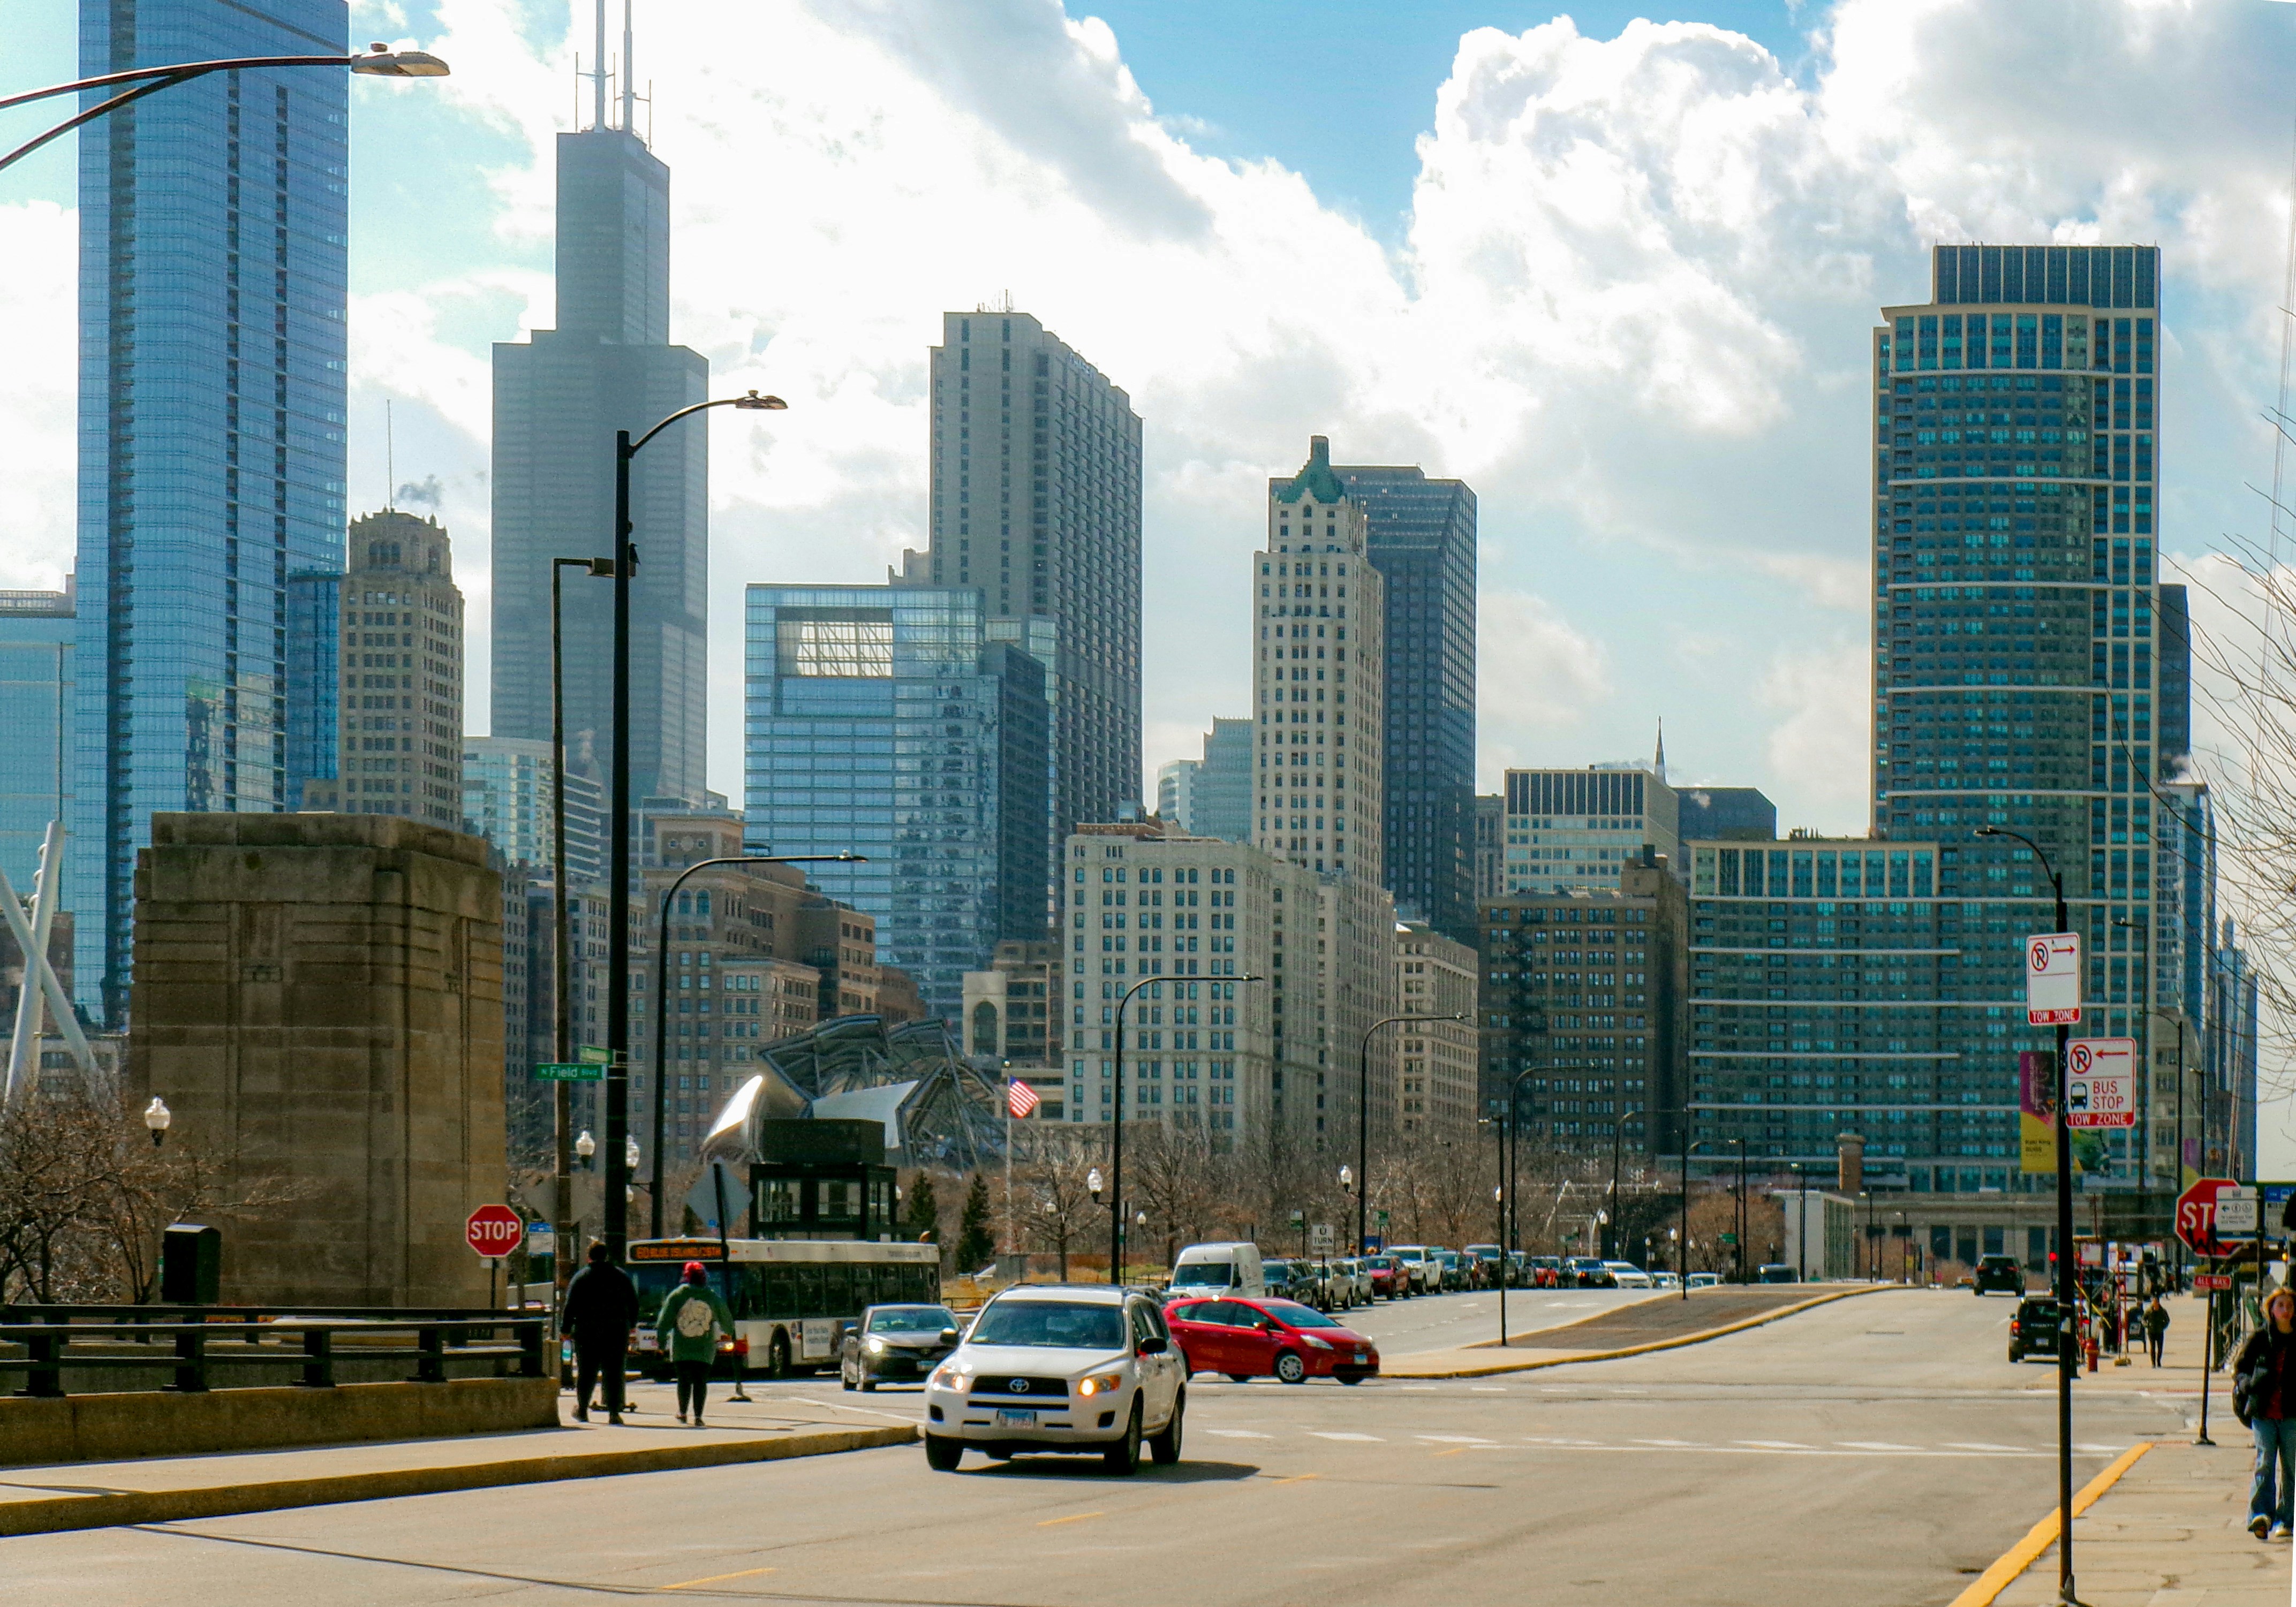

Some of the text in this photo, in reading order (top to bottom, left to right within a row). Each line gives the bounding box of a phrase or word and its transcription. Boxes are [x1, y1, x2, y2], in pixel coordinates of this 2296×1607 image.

[2032, 1009, 2075, 1022] TOW ZONE
[550, 1066, 578, 1078] Field
[2093, 1080, 2118, 1094] BUS
[2093, 1096, 2124, 1110] STOP
[2070, 1113, 2127, 1125] TOW ZONE
[2181, 1201, 2214, 1231] ST
[470, 1221, 518, 1241] STOP
[2197, 1277, 2229, 1286] ALL WAY
